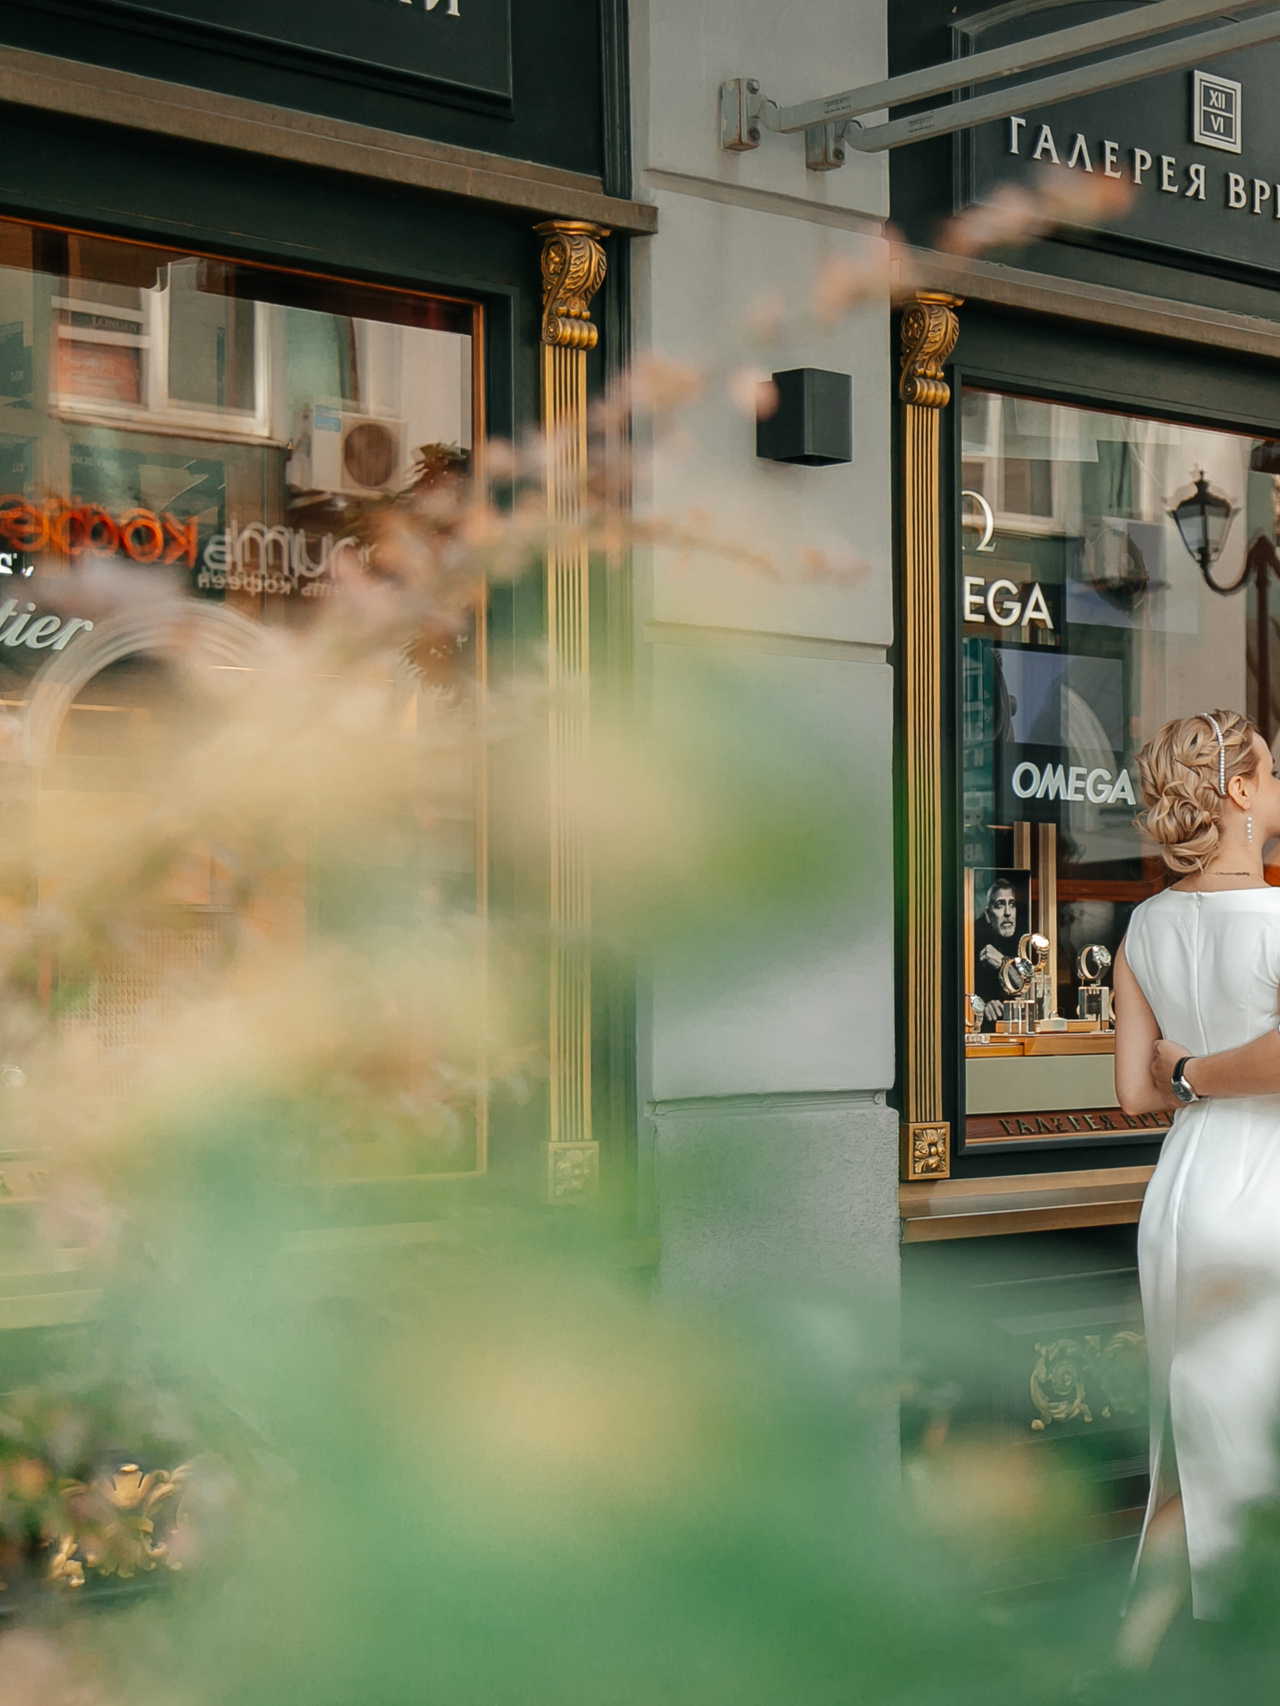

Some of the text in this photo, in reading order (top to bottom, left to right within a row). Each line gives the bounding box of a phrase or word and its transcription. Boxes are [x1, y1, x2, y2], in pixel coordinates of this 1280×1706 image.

[1209, 89, 1226, 110] XII
[1210, 114, 1224, 134] VI
[1009, 116, 1207, 201] ГАЛЕРЕЯ
[1012, 761, 1137, 806] OMEGA
